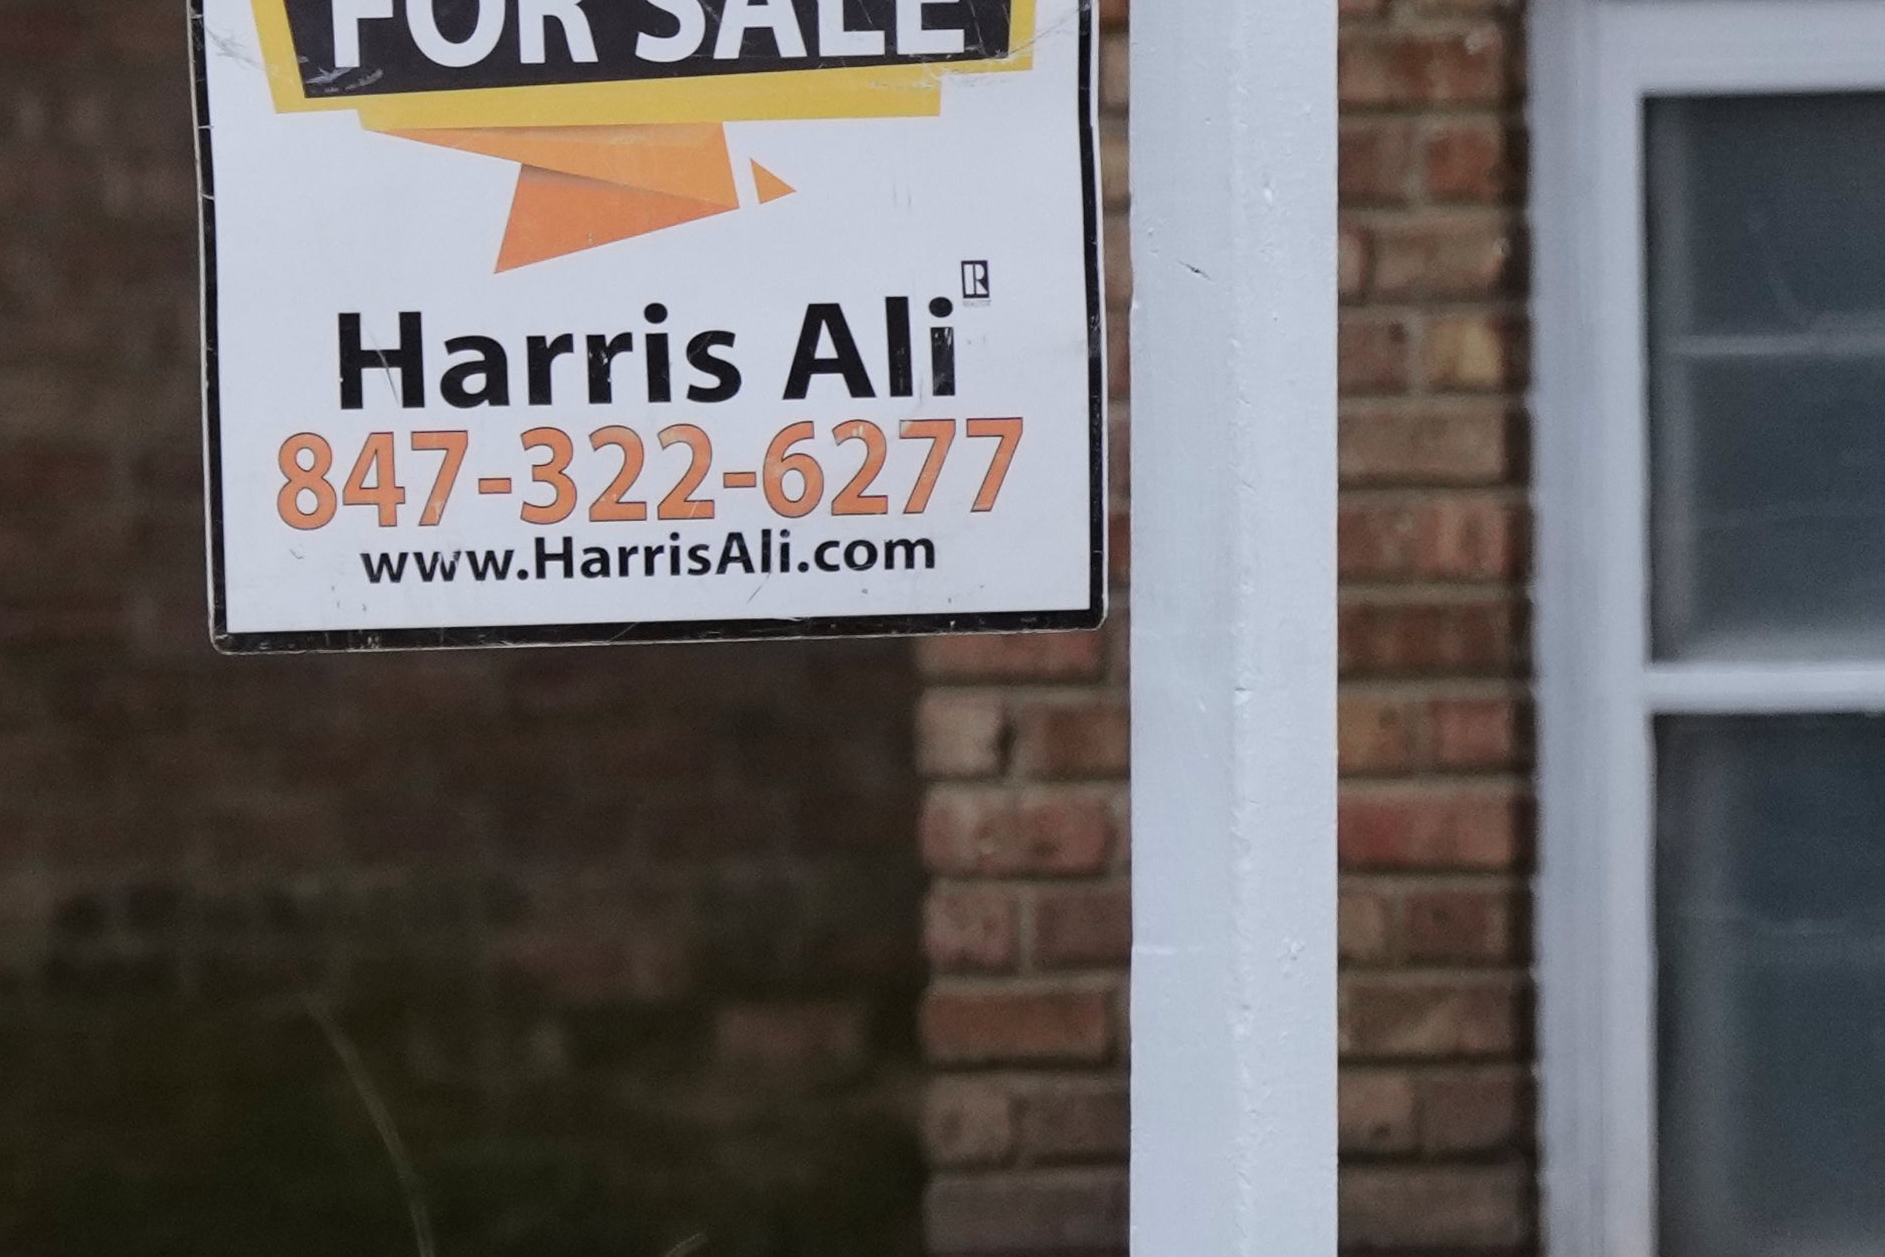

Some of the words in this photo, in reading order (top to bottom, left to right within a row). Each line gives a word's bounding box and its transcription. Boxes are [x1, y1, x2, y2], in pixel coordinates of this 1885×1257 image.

[337, 302, 743, 410] Harris
[781, 296, 957, 400] Ali
[277, 416, 1024, 530] 847-322-6277
[360, 528, 937, 584] www.HarrisAli.com
